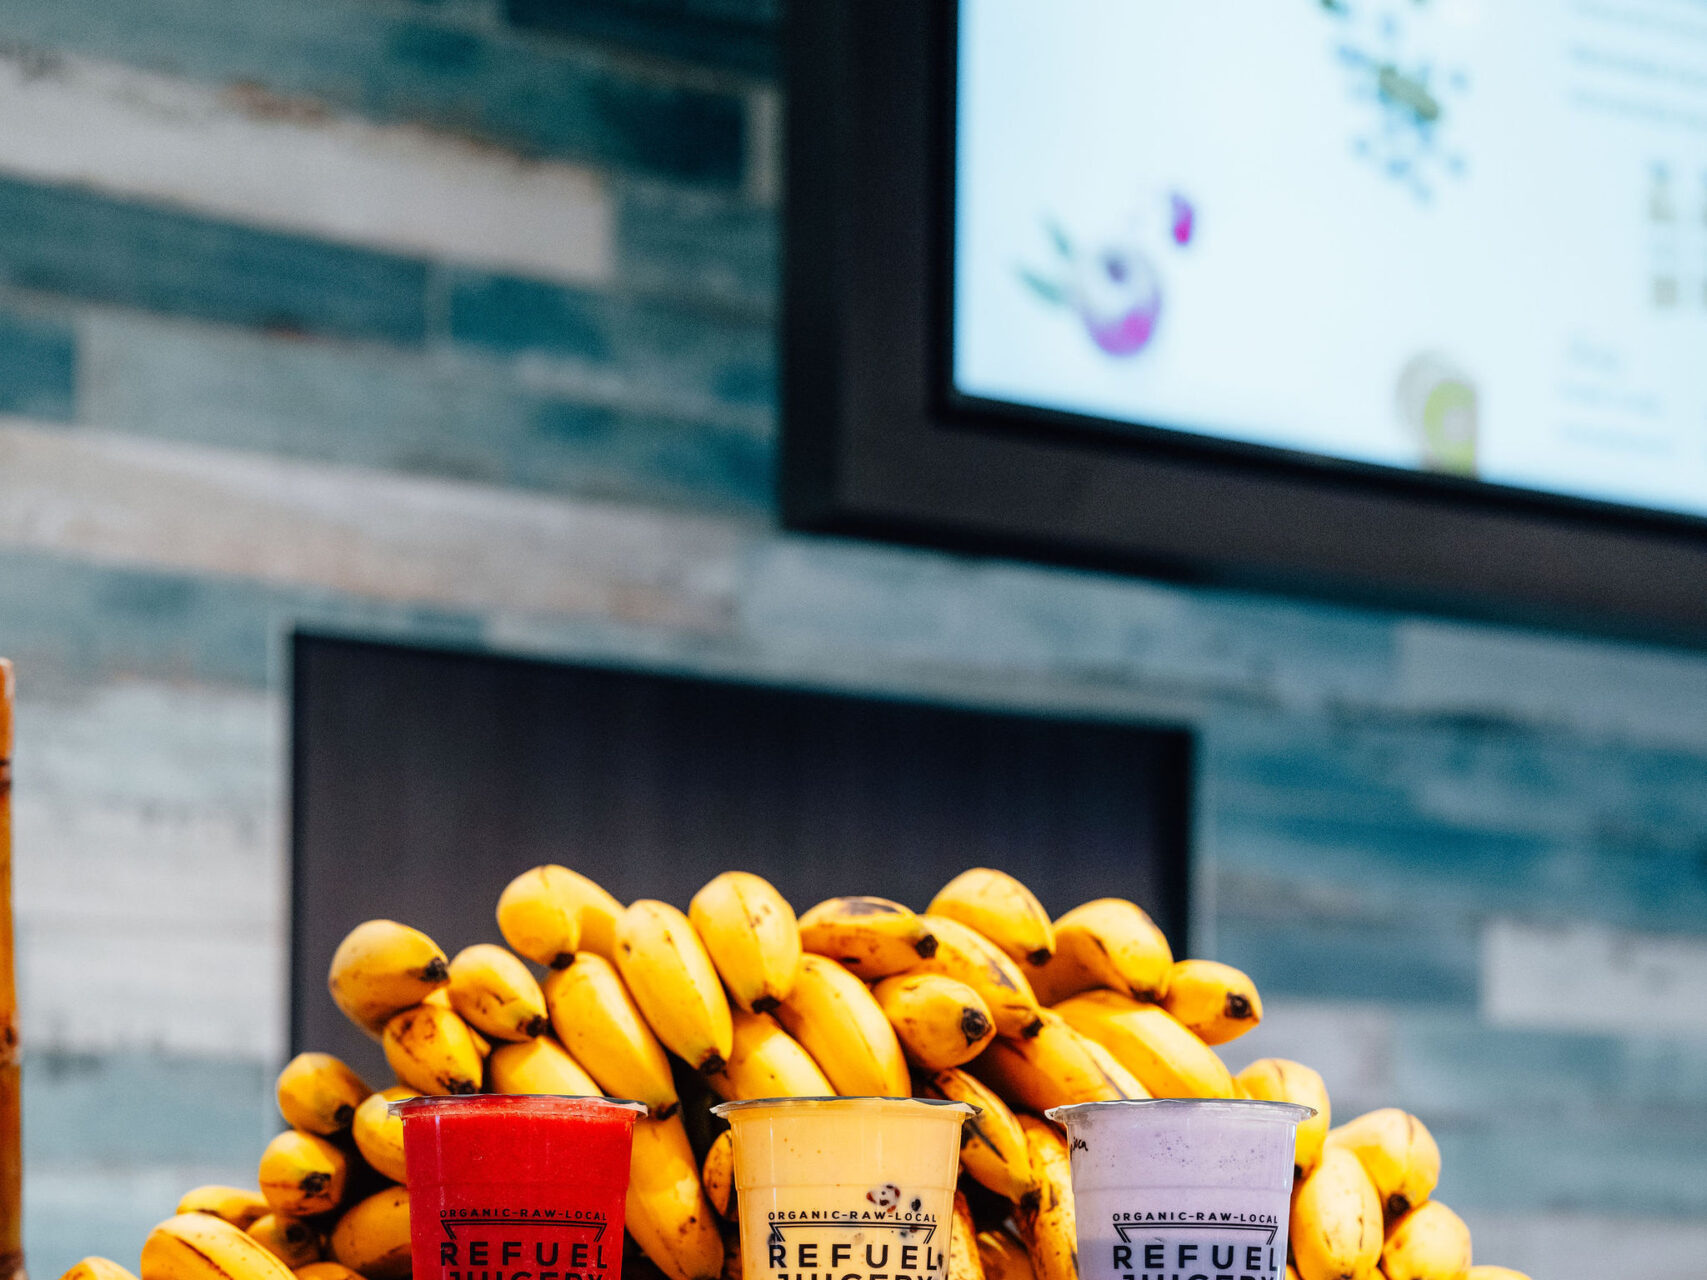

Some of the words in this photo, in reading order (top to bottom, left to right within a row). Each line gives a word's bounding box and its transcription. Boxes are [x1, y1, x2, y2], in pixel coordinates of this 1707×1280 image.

[440, 1241, 607, 1269] REFUEL
[768, 1243, 938, 1271] REFUEL
[1113, 1244, 1278, 1271] REFUEL
